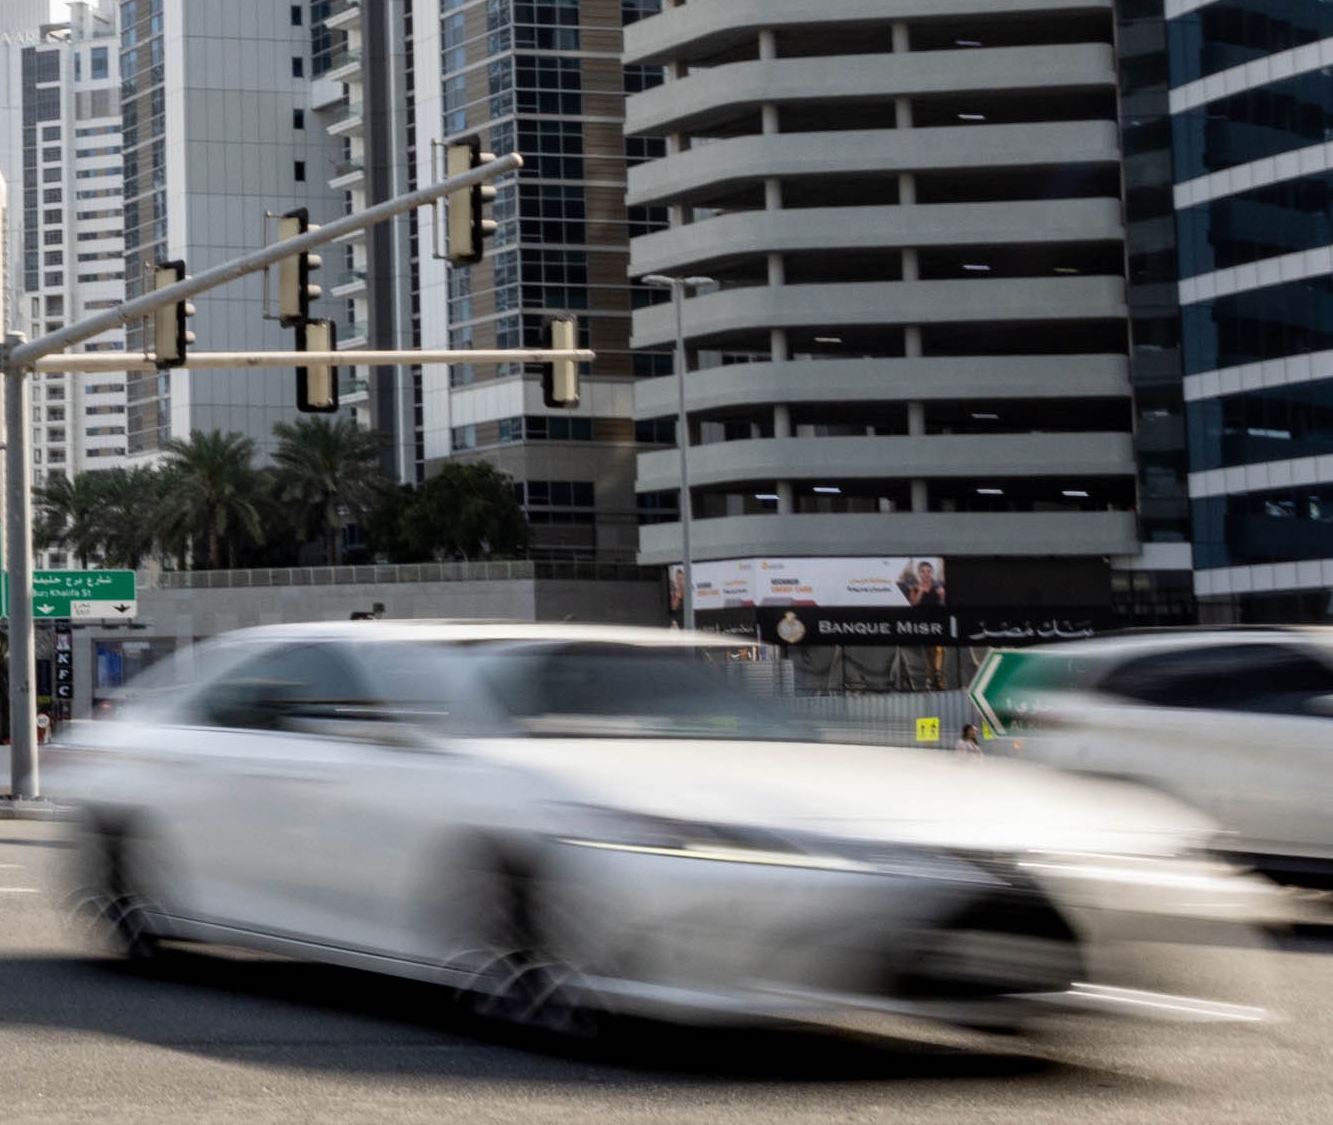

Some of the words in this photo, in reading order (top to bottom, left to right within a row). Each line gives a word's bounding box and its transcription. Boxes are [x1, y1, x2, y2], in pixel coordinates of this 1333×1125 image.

[50, 588, 81, 597] Khalifa
[81, 588, 93, 597] St
[818, 619, 891, 636] BANQUE
[57, 652, 70, 696] KFC
